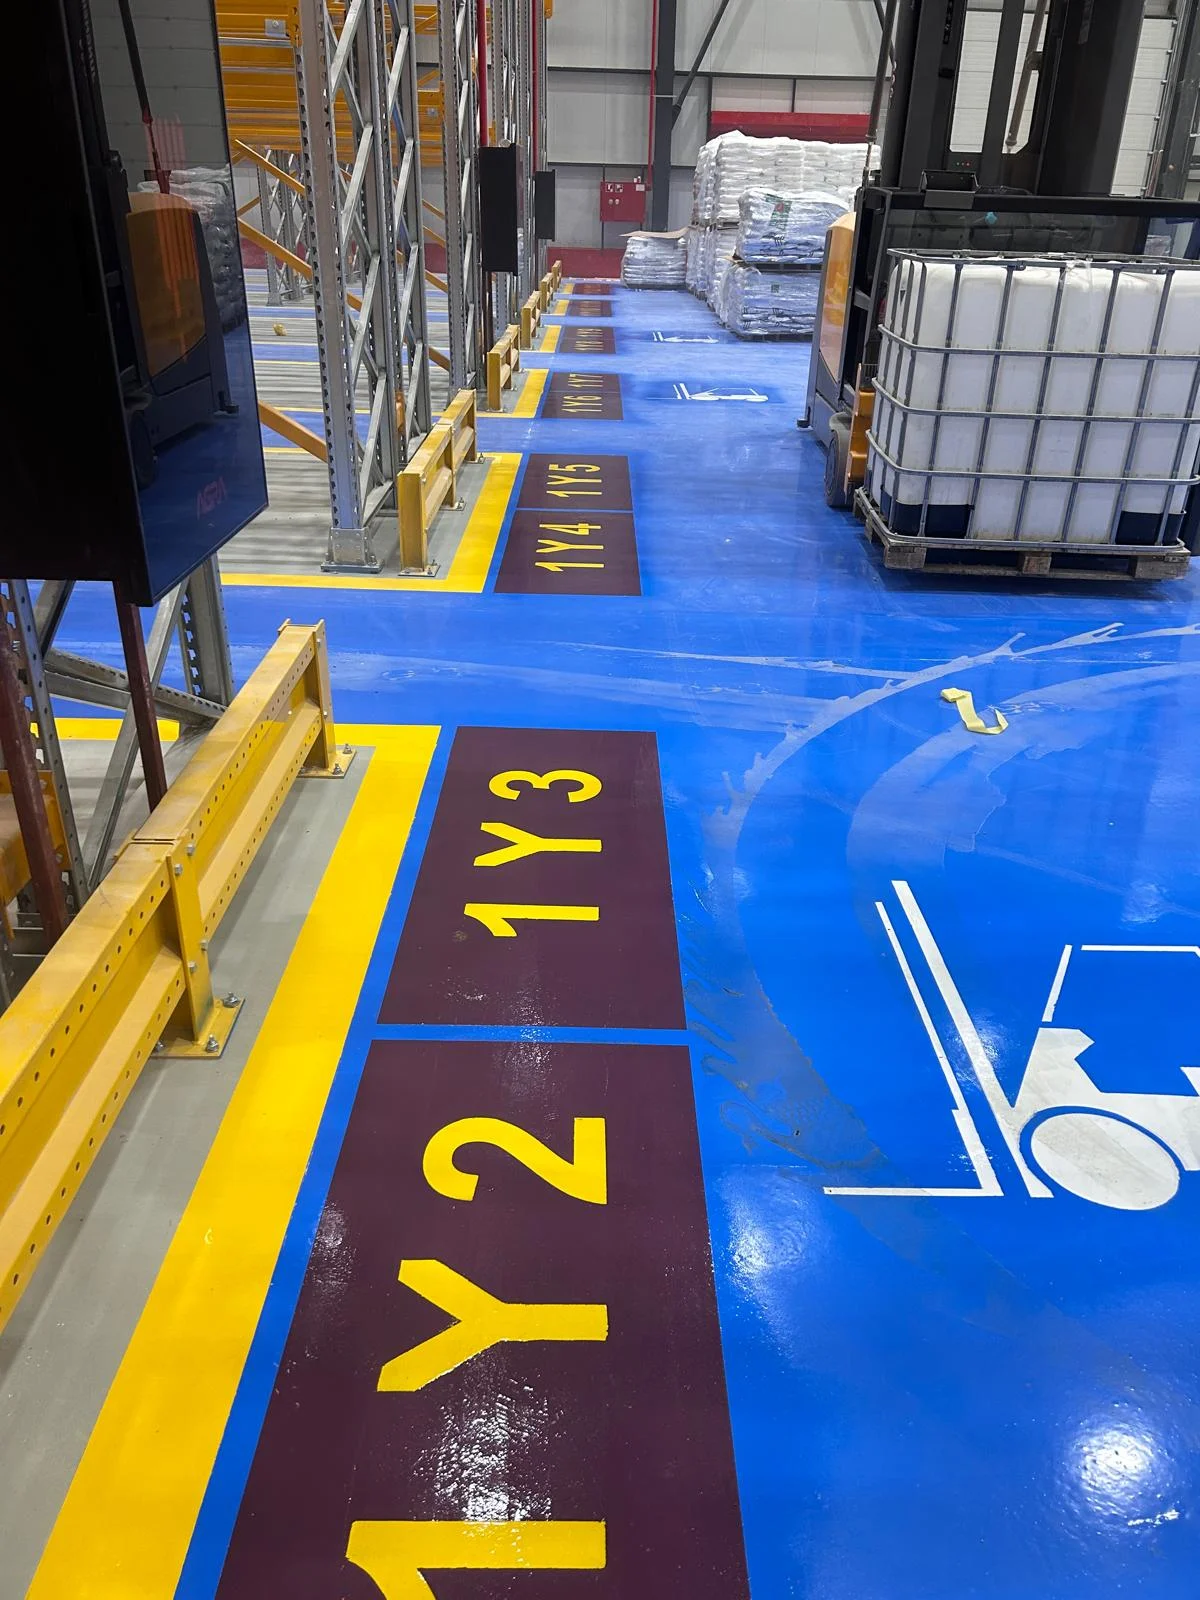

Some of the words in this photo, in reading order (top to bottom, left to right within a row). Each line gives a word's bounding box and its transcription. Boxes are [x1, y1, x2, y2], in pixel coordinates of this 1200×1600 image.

[567, 373, 604, 388] 1Y7
[561, 394, 603, 412] 1Y6
[546, 463, 602, 498] 1Y5
[534, 523, 605, 572] 1Y4
[463, 769, 602, 937] 1Y3
[346, 1116, 608, 1600] 1Y2
